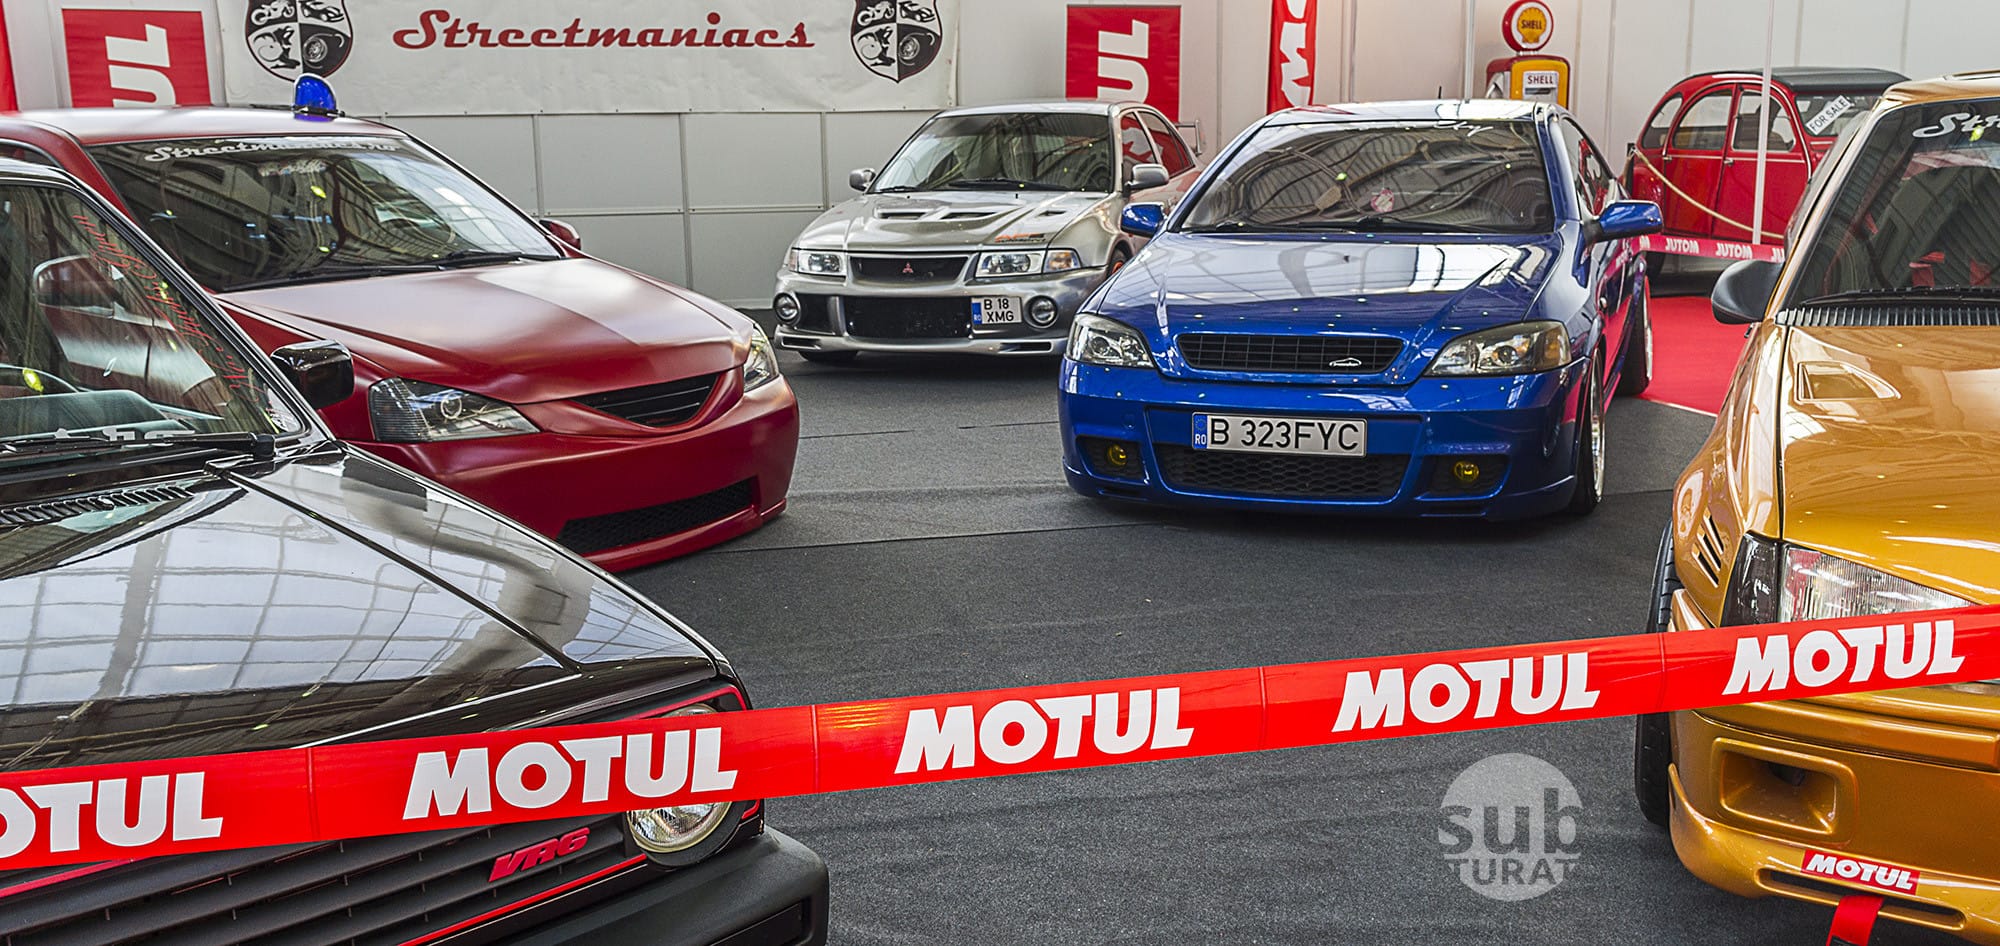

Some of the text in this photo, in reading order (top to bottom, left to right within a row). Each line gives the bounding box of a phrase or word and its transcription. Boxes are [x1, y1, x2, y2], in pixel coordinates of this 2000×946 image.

[392, 9, 816, 49] Streetmaniacs
[1521, 19, 1543, 30] SHELL
[104, 23, 176, 109] UL
[1097, 19, 1149, 104] UL
[1527, 75, 1554, 85] SHELL
[1809, 98, 1849, 131] FOR SALE
[1912, 112, 2000, 139] Str
[984, 298, 1009, 310] B 18
[986, 310, 1014, 322] XMG
[1194, 418, 1359, 451] RO B 323FYC
[1721, 619, 1966, 696] MOTUL
[1331, 651, 1601, 733] MOTUL
[893, 686, 1195, 775] MOTUL
[402, 726, 739, 820] MOTUL
[0, 771, 224, 859] TUL
[488, 826, 591, 883] VR6
[1805, 852, 1914, 891] MOTUL
